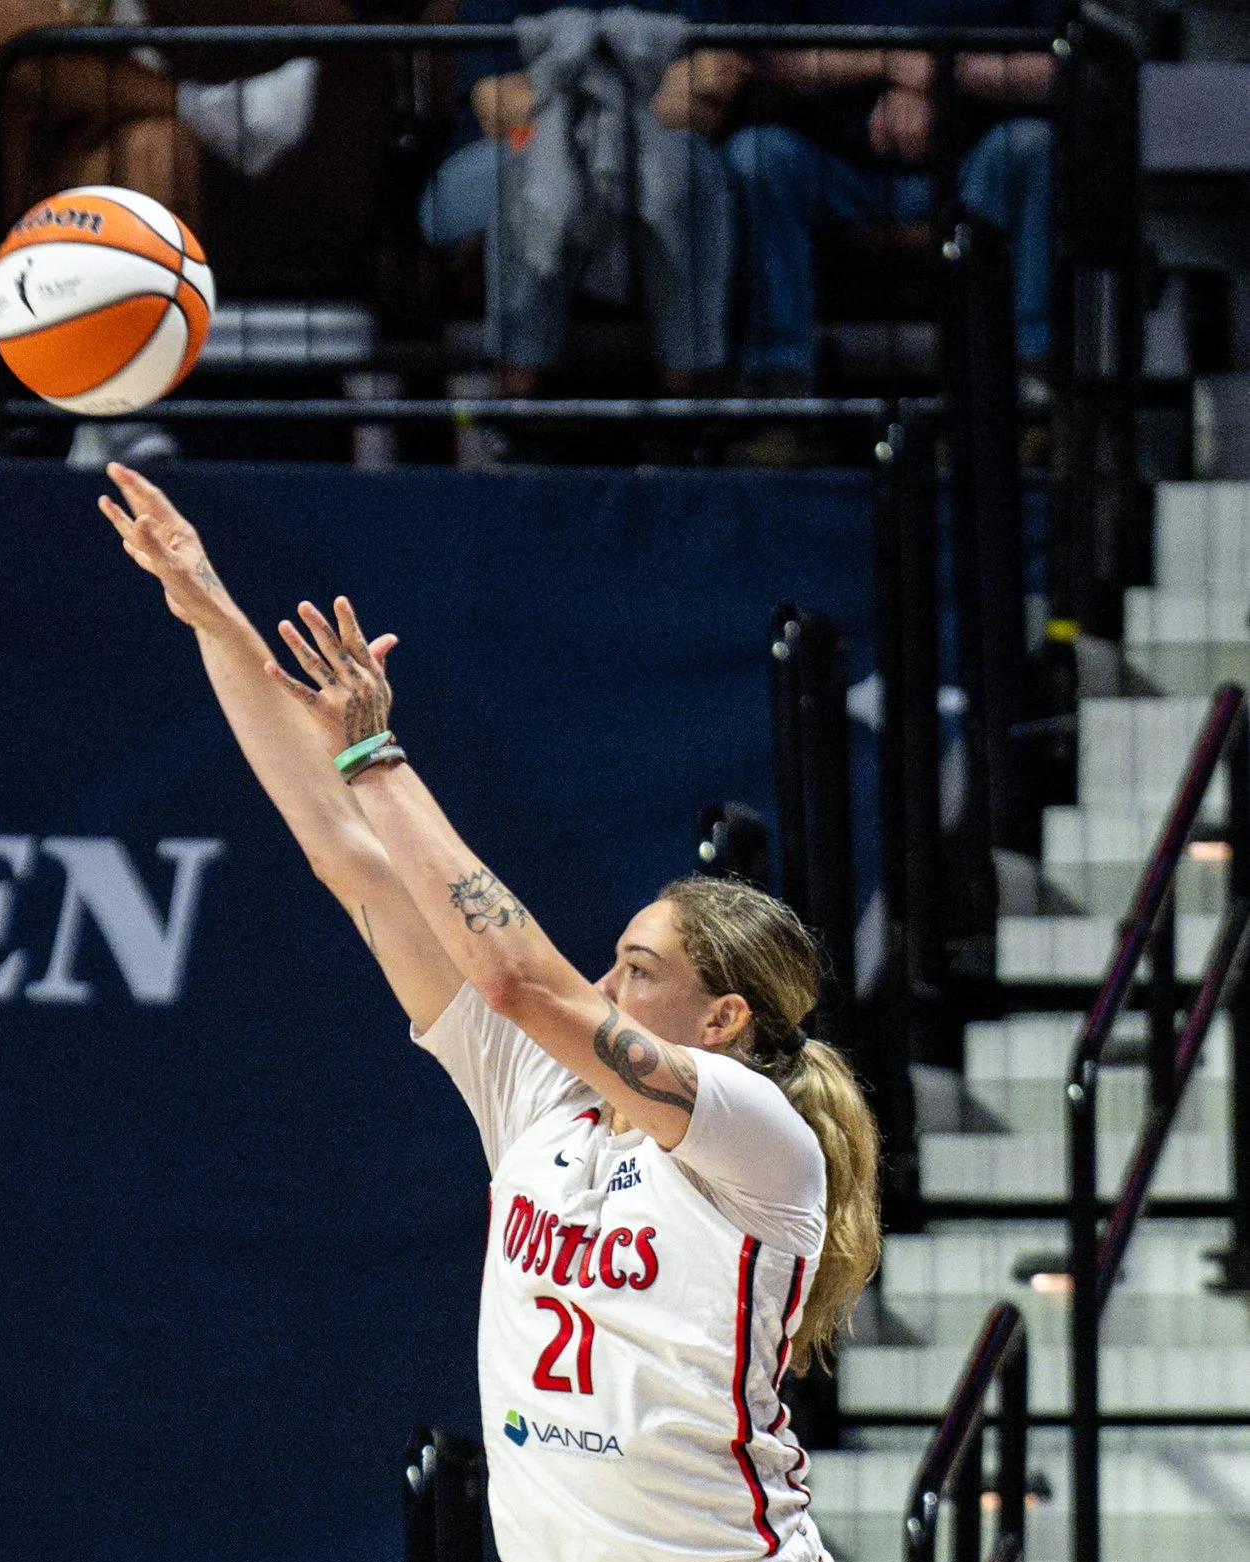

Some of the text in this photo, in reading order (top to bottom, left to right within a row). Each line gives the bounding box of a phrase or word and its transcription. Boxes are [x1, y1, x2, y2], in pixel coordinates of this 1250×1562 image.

[612, 1157, 637, 1176] AR
[532, 1295, 595, 1395] 21
[531, 1421, 624, 1456] VANDA
